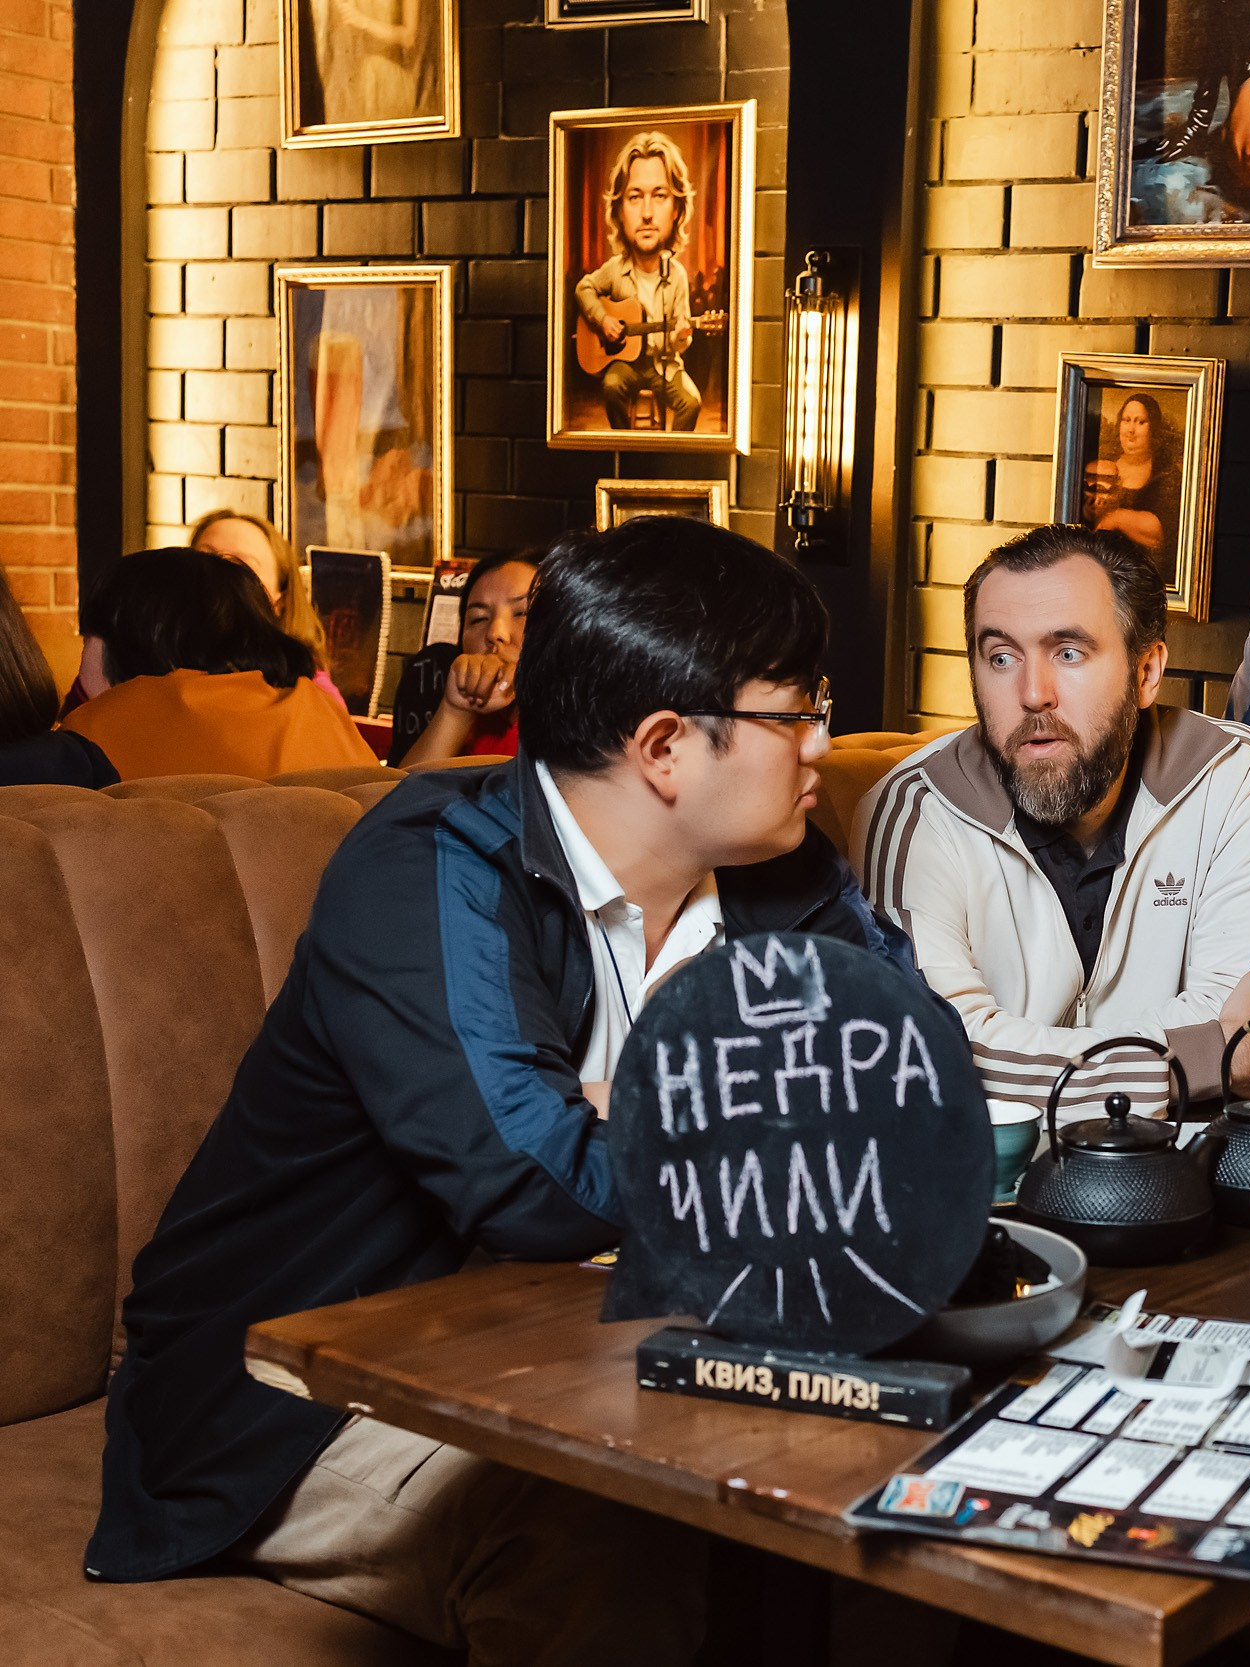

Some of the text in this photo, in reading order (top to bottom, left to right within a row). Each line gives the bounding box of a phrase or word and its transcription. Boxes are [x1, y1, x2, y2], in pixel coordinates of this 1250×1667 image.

[1153, 896, 1188, 907] adidas
[656, 1014, 943, 1135] НЕДРА
[659, 1137, 891, 1252] ЧИЛИ
[695, 1357, 880, 1411] КВИЗ, ПЛИЗ!
